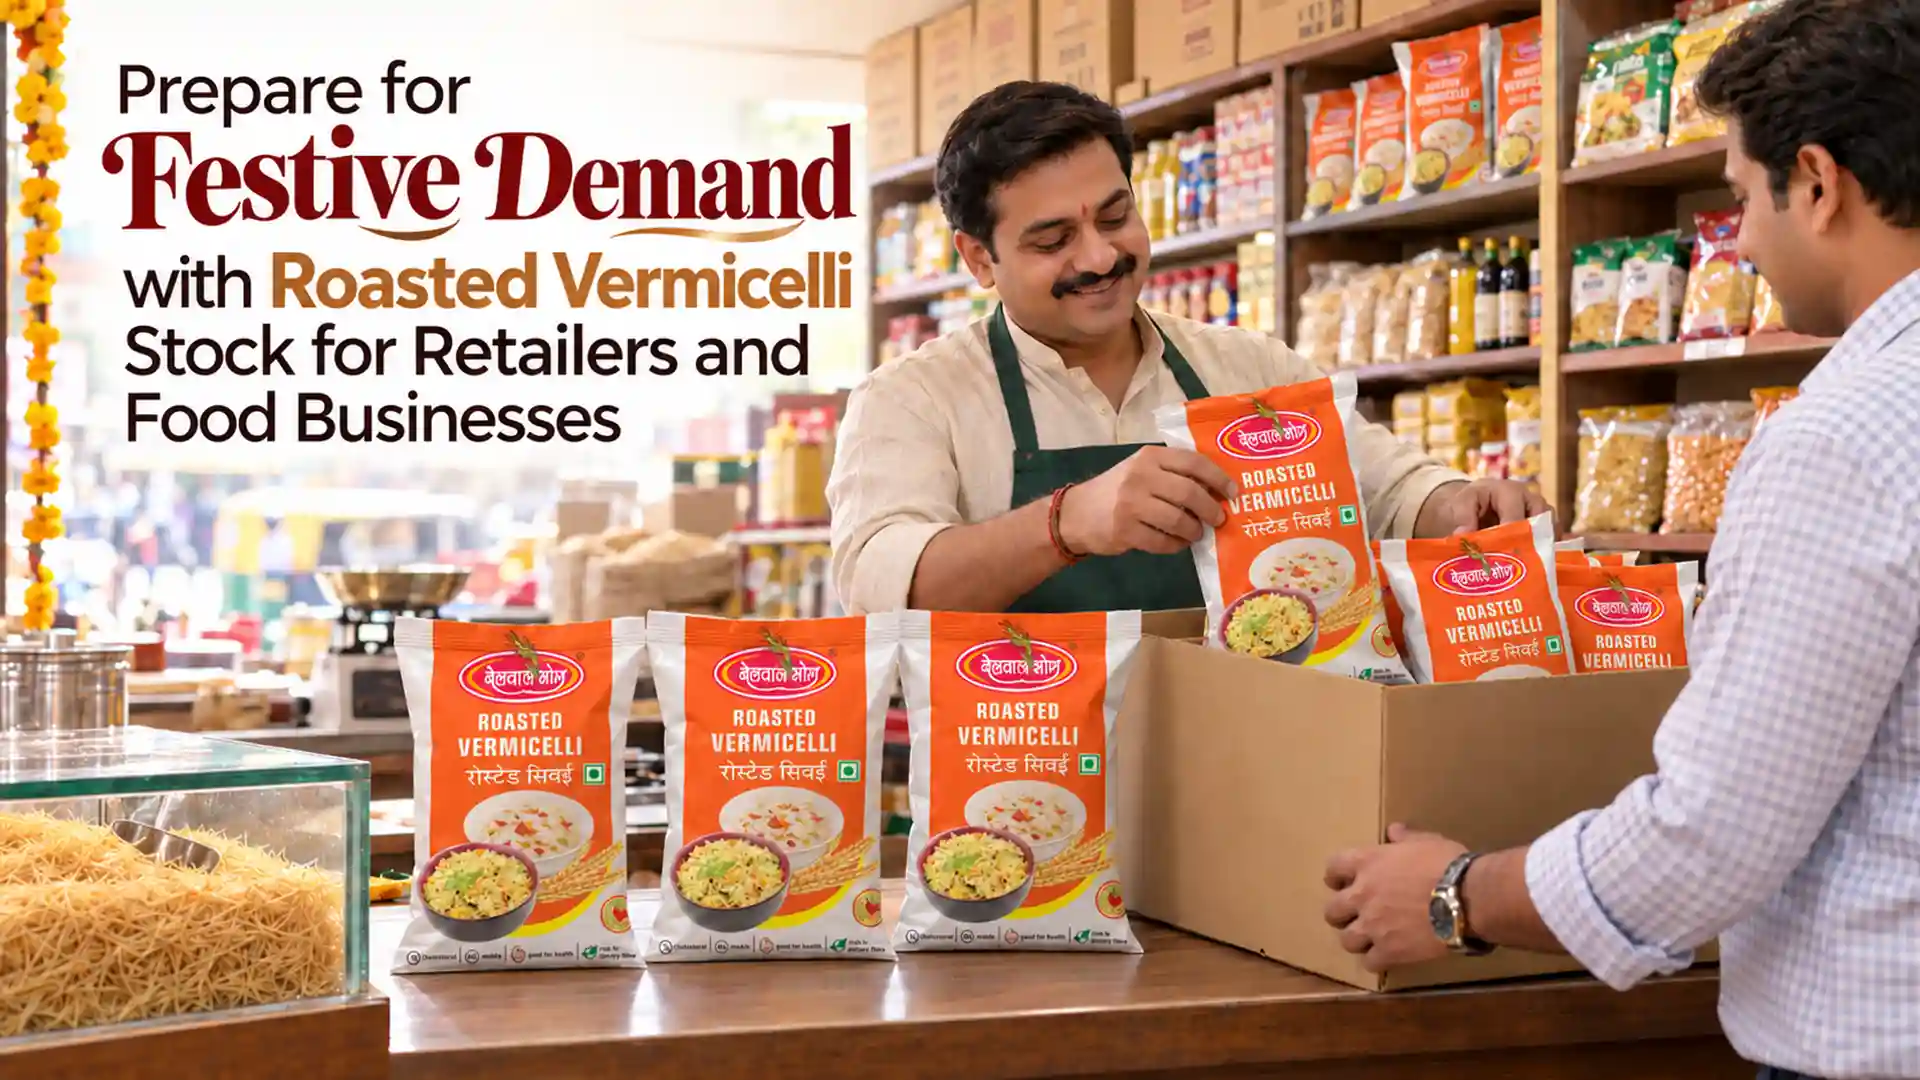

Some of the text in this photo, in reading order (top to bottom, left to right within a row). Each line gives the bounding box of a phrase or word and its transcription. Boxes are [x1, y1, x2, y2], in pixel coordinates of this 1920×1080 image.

[1241, 462, 1316, 489] ROASTED
[1230, 481, 1336, 515] VERMICELLI
[1455, 598, 1523, 622] ROASTED
[1445, 616, 1543, 645] VERMICELLI
[1596, 635, 1656, 648] ROASTED
[1582, 652, 1674, 670] VERMICELLI
[734, 709, 815, 726] ROASTED
[977, 702, 1058, 720] ROASTED
[478, 712, 562, 731] ROASTED
[711, 733, 836, 752] VERMICELLI
[958, 727, 1078, 745] VERMICELLI
[458, 736, 581, 756] VERMICELLI
[719, 760, 774, 780] रोस्टेड
[966, 753, 1018, 772] रोस्टेड
[466, 765, 521, 785] रोस्टेड
